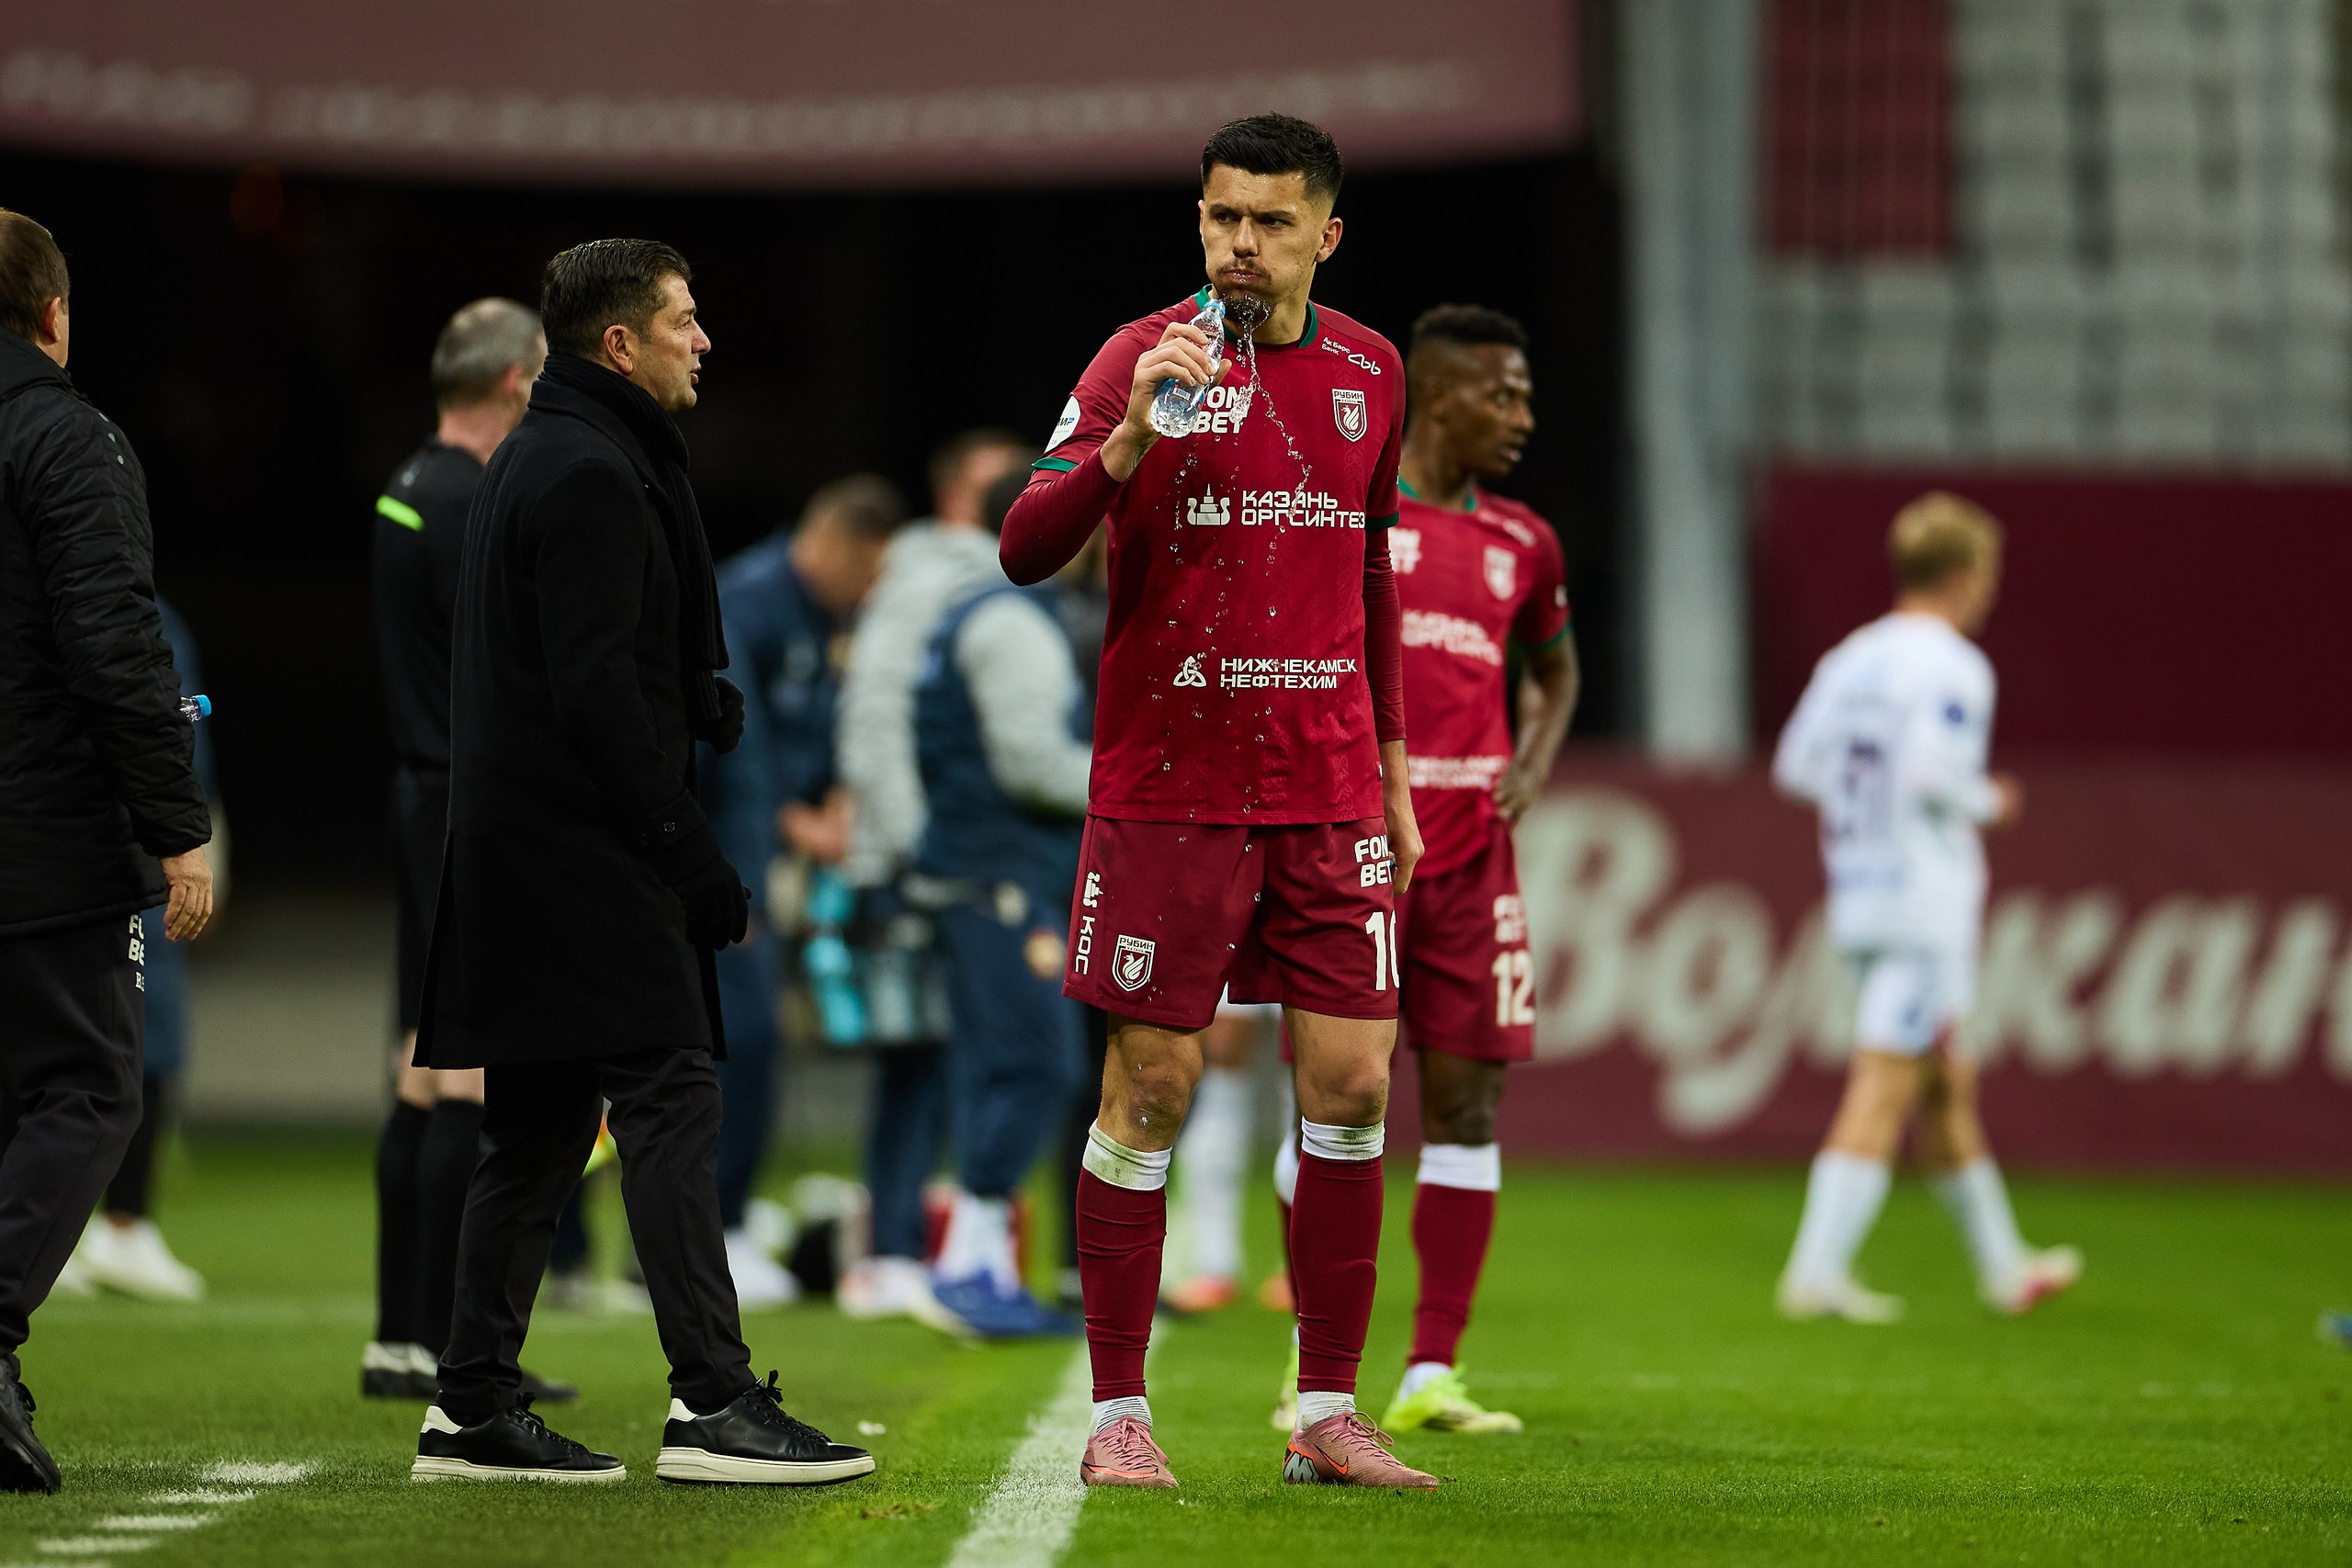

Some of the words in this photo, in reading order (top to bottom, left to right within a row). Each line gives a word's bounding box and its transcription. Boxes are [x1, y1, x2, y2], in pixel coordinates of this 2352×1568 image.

[1206, 386, 1248, 409] ON
[1333, 390, 1363, 400] РУБИН
[1242, 490, 1339, 510] КАЗАНЬ
[1241, 508, 1366, 529] ОРГСИНТЕЗ
[1221, 658, 1358, 673] НИЖНЕКАМСК
[1220, 673, 1338, 689] НЕФТЕХИМ
[1075, 915, 1096, 976] КОС
[1120, 937, 1153, 951] РУБИН
[1491, 951, 1535, 1028] 12
